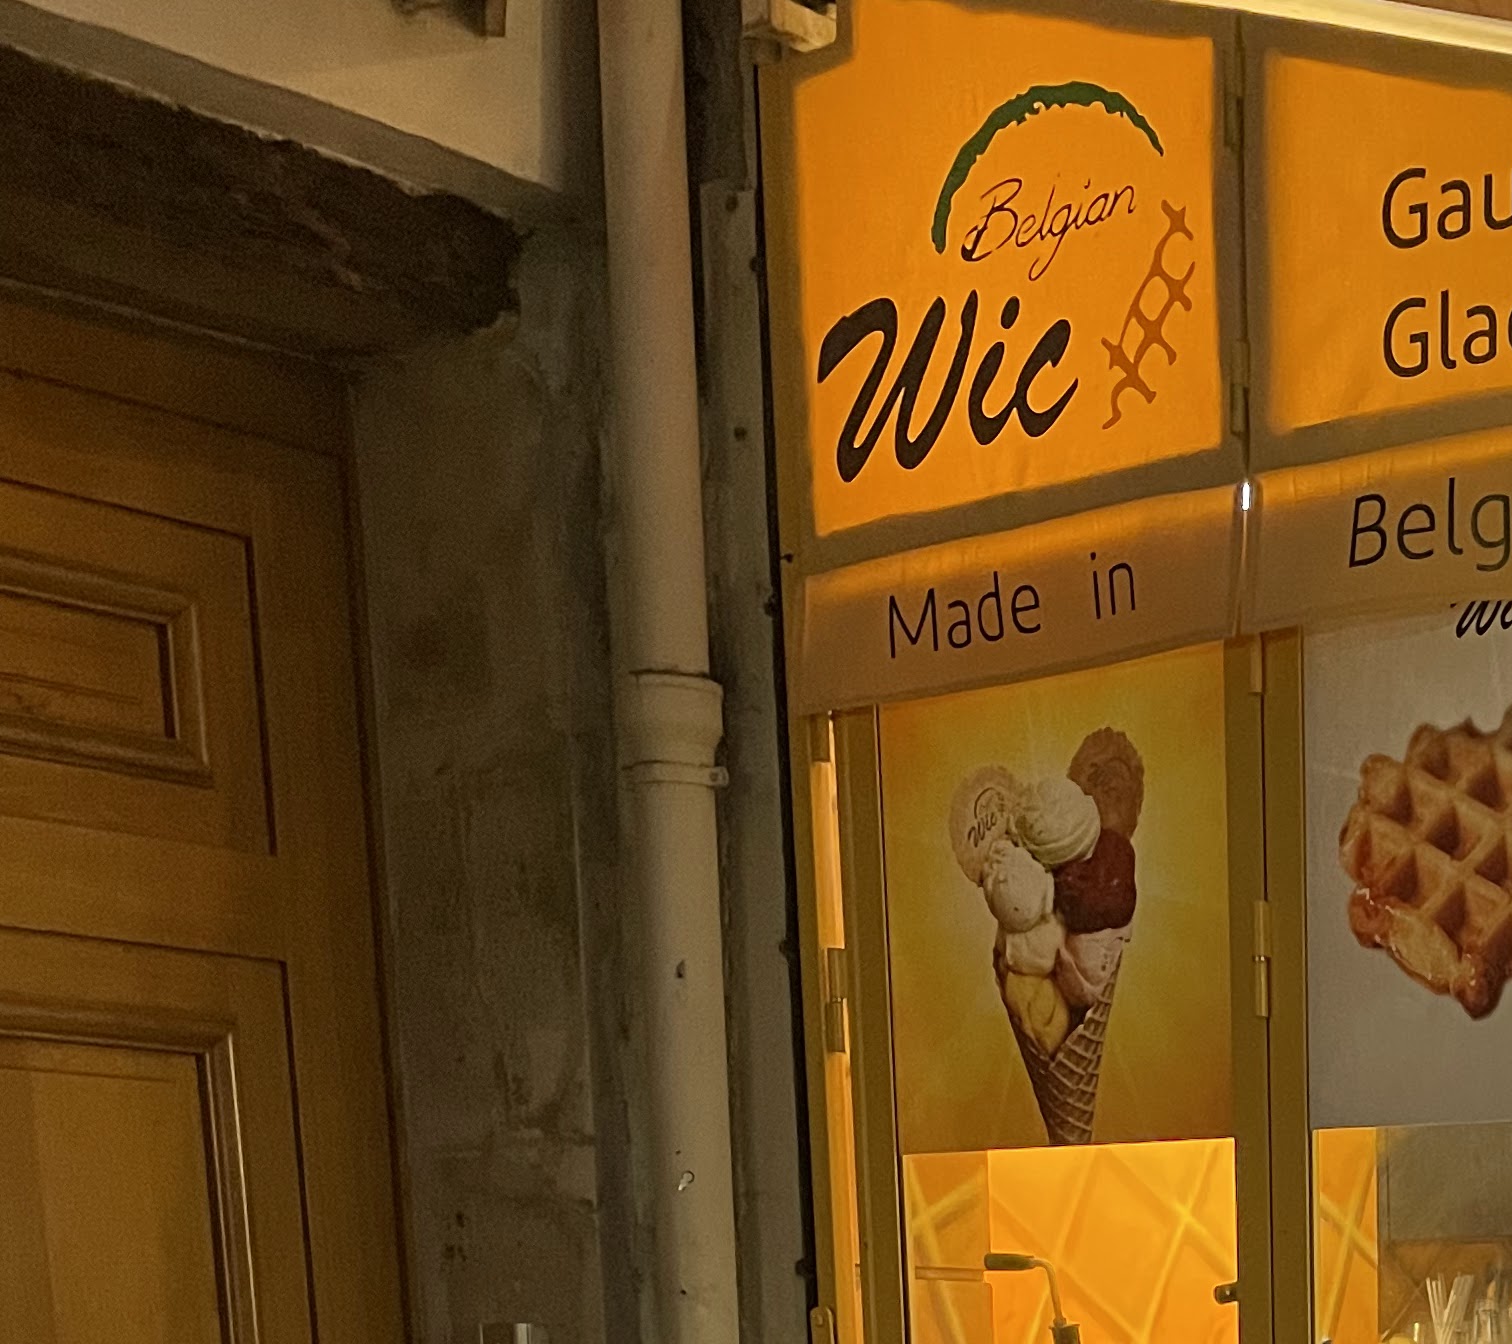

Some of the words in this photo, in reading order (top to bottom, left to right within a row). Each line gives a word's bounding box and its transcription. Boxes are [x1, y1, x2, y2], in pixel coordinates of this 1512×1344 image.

[960, 177, 1137, 282] Belgian
[817, 289, 1079, 483] Wic
[888, 570, 1041, 659] Made
[1090, 551, 1137, 621] in
